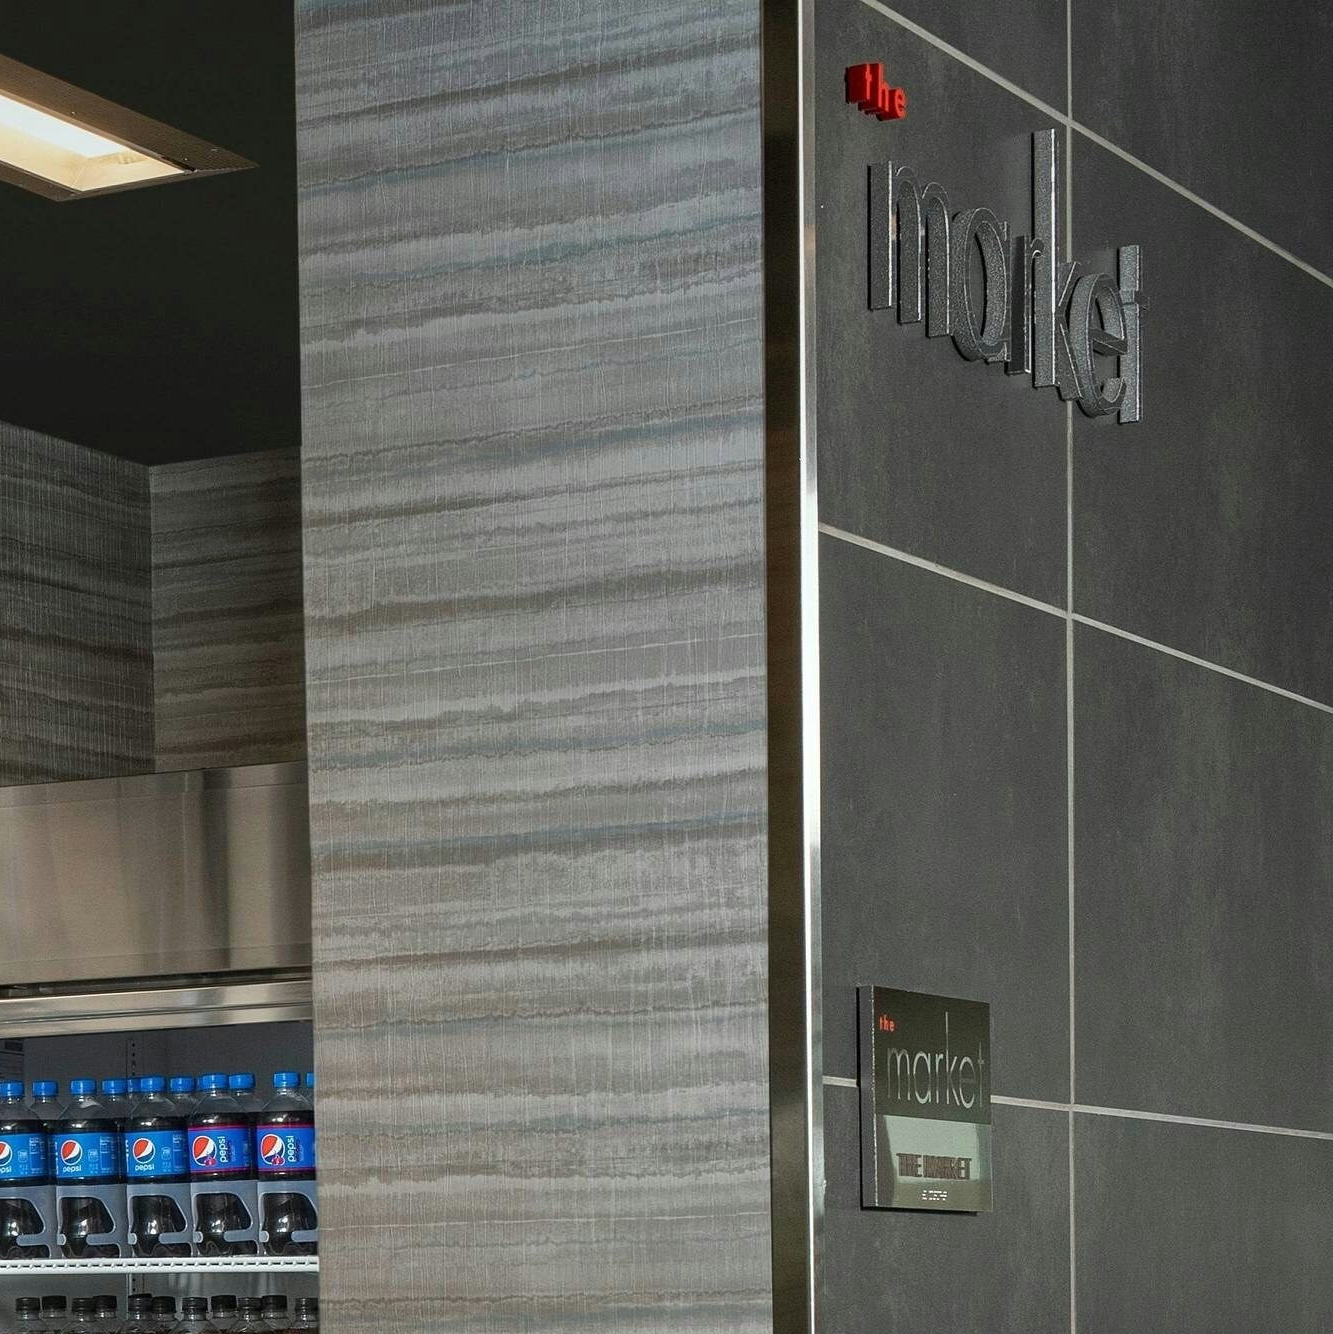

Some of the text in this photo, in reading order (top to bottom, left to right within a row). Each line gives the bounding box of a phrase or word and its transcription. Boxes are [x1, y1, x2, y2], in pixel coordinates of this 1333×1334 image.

[847, 62, 907, 121] the
[867, 128, 1148, 425] market
[879, 1016, 895, 1032] the
[886, 1010, 985, 1109] market
[216, 1135, 228, 1163] pepsi
[285, 1135, 297, 1163] pepsi
[62, 1165, 82, 1174] pepsi
[134, 1163, 155, 1172] pepsi
